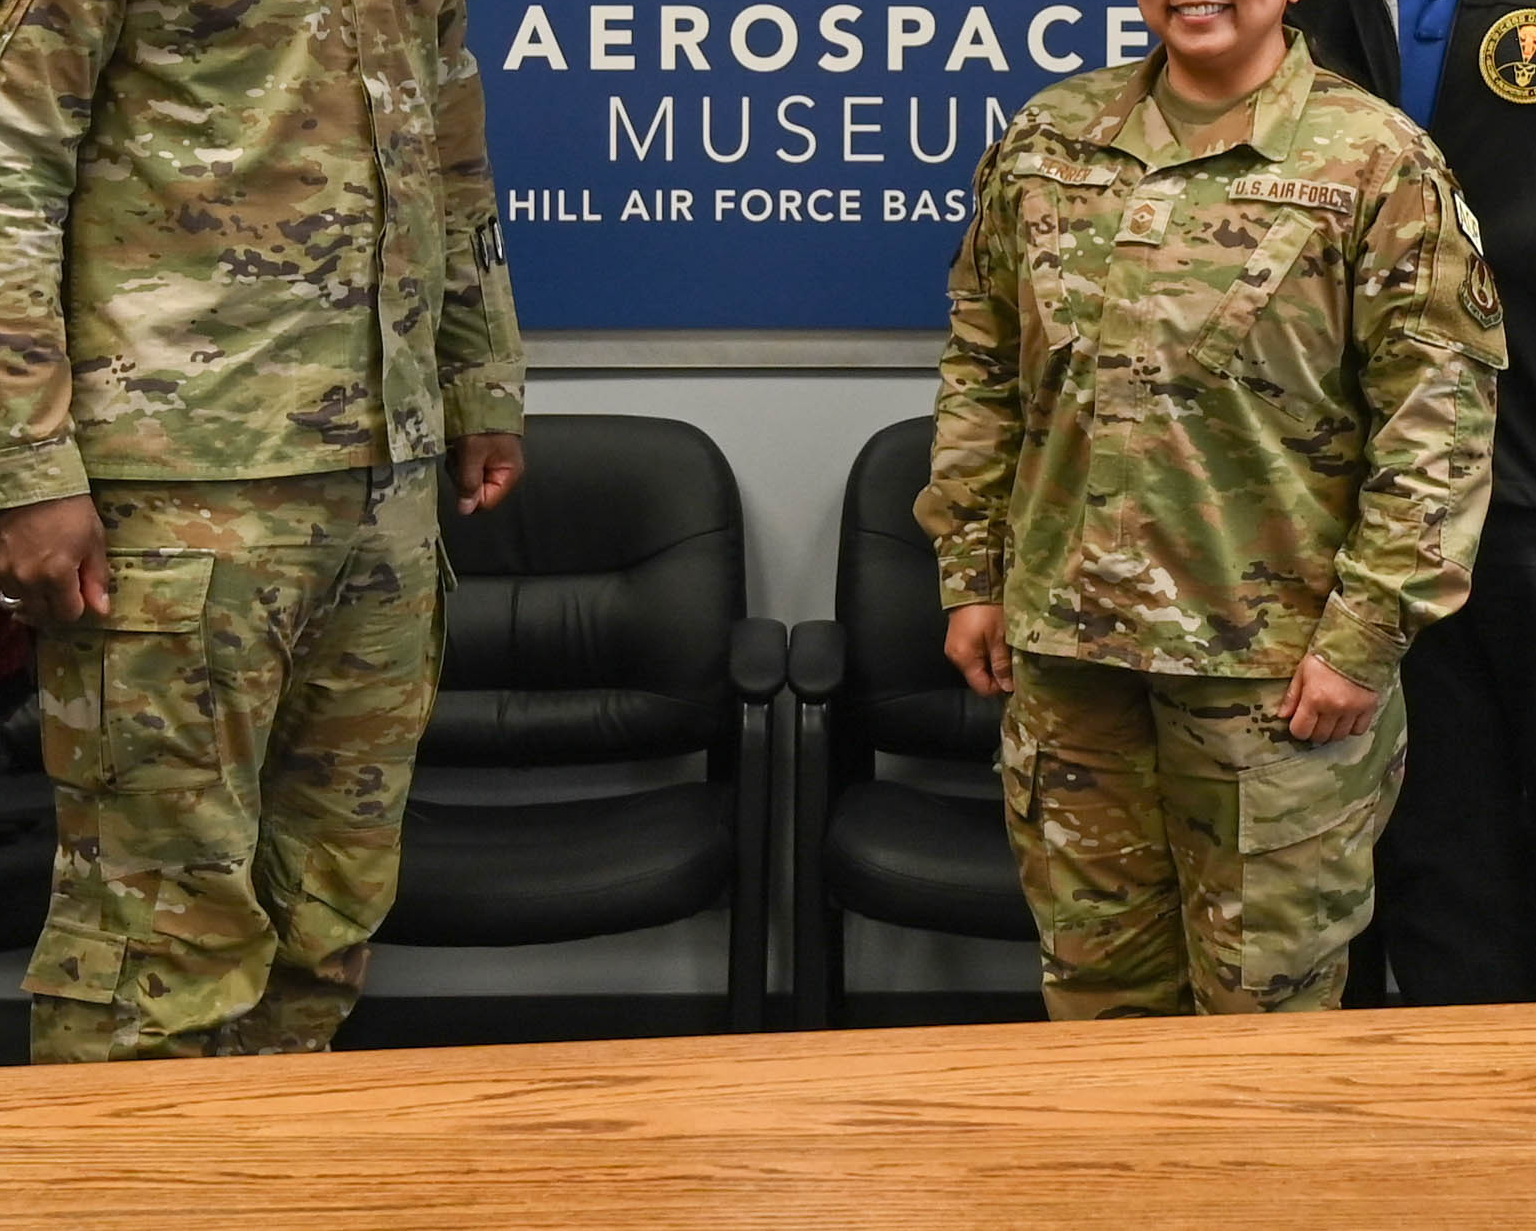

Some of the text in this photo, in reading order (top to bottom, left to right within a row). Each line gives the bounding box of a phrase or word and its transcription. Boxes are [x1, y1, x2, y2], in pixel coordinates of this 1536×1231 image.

[502, 4, 1149, 73] AEROSPACE
[508, 188, 975, 223] HILL AIR FORCE BAS
[1235, 181, 1264, 197] U.S.
[1268, 181, 1296, 199] AIR
